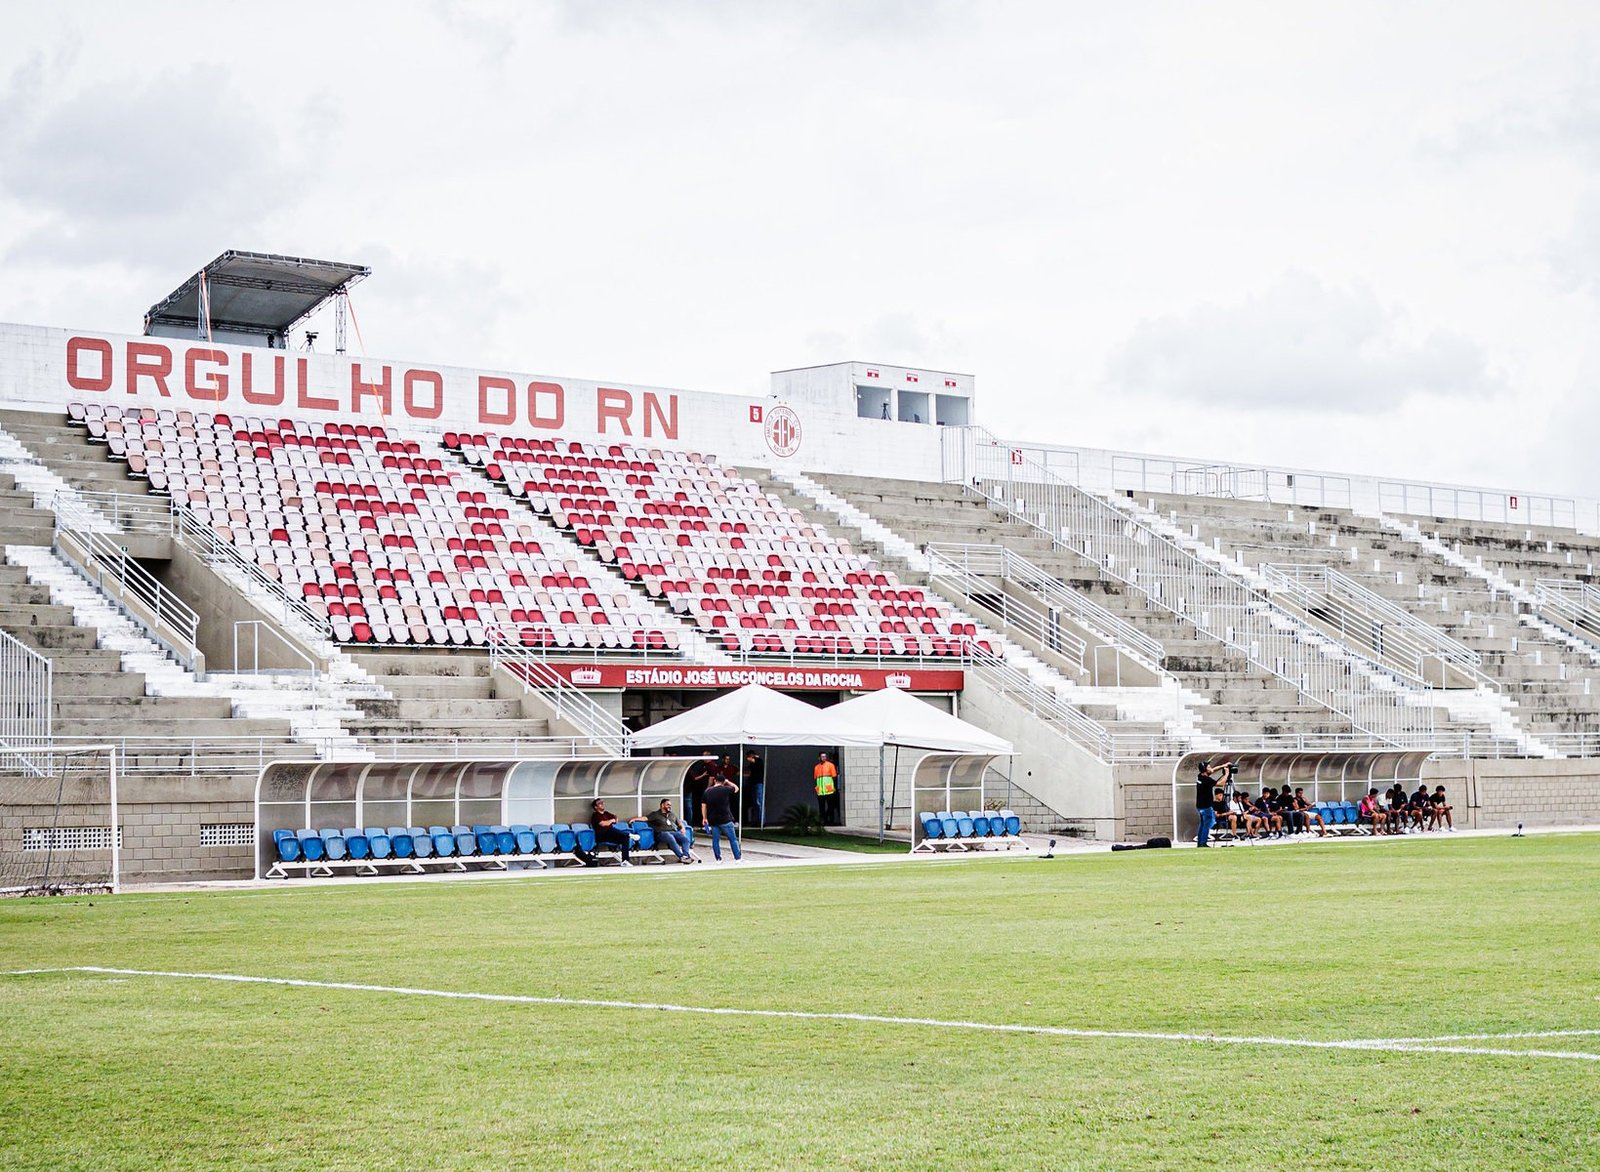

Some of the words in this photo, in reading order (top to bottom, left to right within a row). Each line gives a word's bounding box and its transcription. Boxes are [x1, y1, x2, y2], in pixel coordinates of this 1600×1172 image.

[67, 337, 443, 419] ORGULHO
[479, 376, 564, 429] DO
[598, 387, 678, 440] RN
[626, 668, 682, 685] ESTÁDIO
[684, 669, 716, 685] JOSÉ
[717, 670, 804, 687] VASCONCELOS
[805, 673, 822, 686] DA
[822, 673, 863, 687] ROCHA
